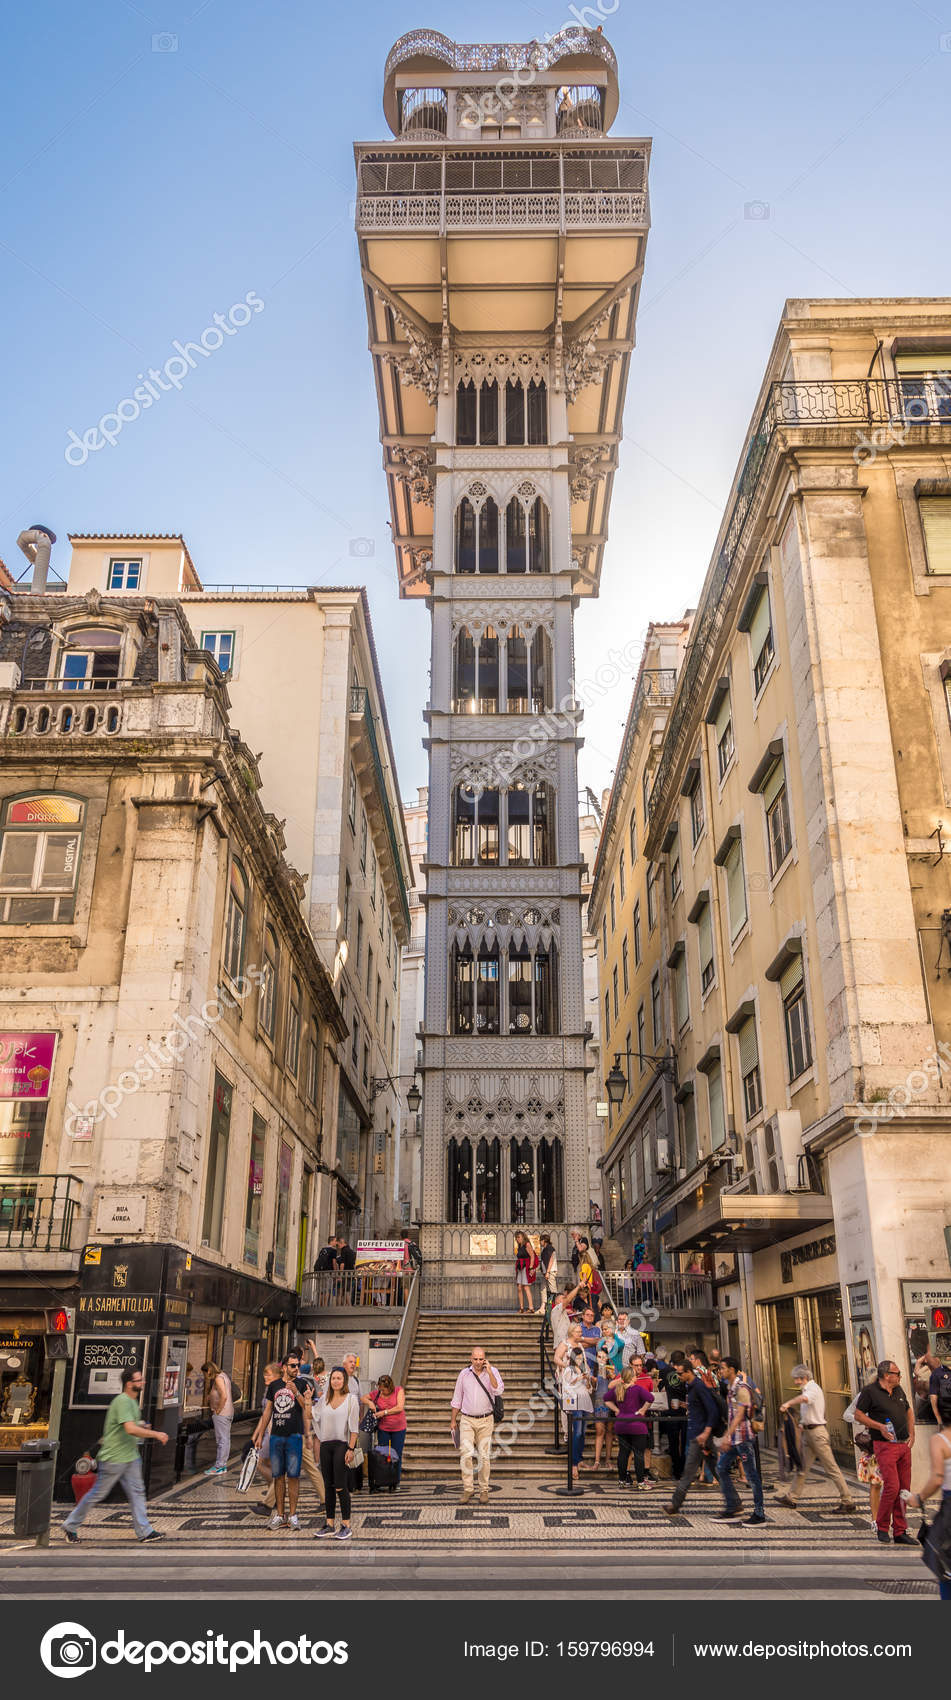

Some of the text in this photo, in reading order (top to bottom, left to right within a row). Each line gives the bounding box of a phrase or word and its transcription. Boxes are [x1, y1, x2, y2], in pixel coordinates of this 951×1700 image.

[64, 838, 76, 871] DIGITAL
[0, 1065, 26, 1075] iental
[111, 1214, 131, 1222] ÁUREA
[791, 1234, 837, 1266] TORRES
[84, 1345, 124, 1357] ESPAÇO
[83, 1355, 137, 1366] SARMENTO
